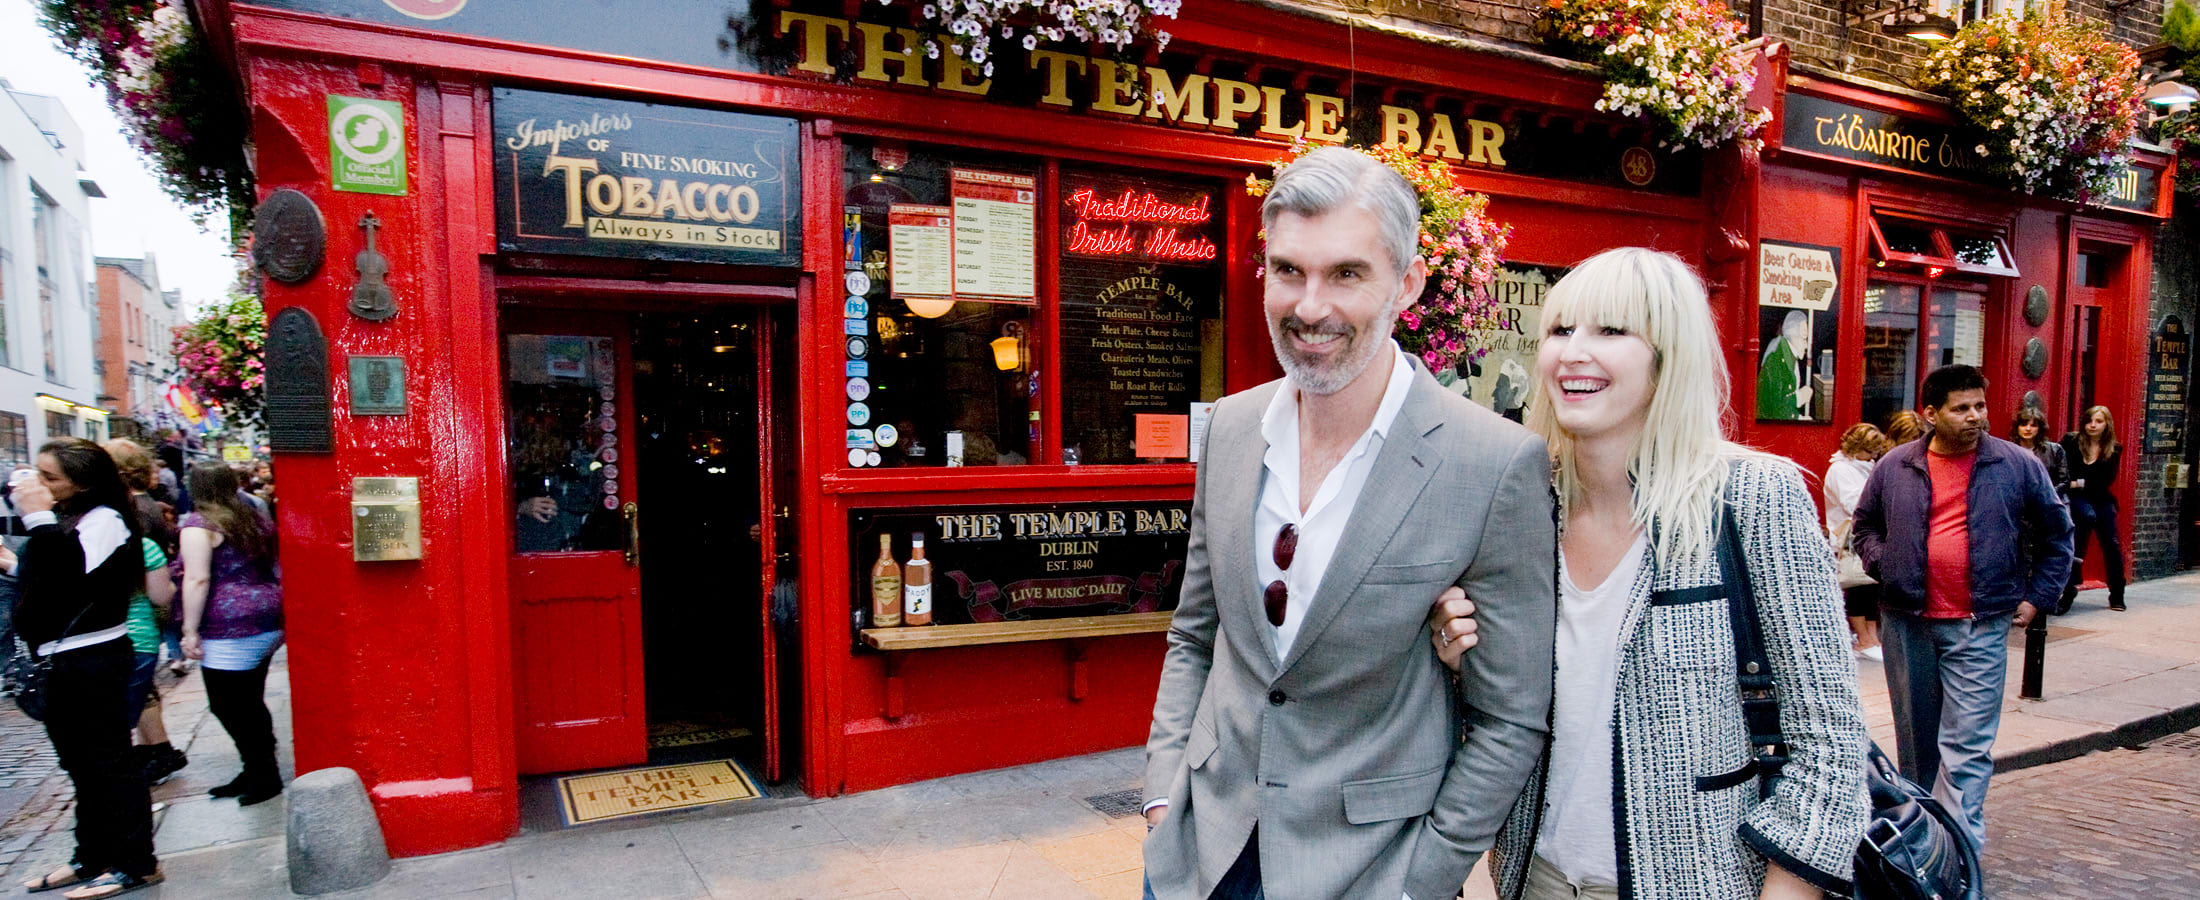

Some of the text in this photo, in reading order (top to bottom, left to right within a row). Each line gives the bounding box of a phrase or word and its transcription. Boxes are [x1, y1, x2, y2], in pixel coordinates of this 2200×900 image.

[780, 10, 1507, 167] THE TEMPLE BAR
[507, 112, 632, 154] Importers
[587, 138, 610, 152] OF
[347, 162, 390, 175] Official
[621, 151, 758, 179] FINE SMOKING
[345, 171, 394, 186] Member
[955, 170, 973, 178] THE
[974, 172, 1012, 182] TEMPLE
[543, 155, 760, 228] TOBACCO
[1073, 190, 1210, 221] Traditional
[592, 219, 777, 246] Always in Stock
[1069, 221, 1216, 259] Irish Music
[1763, 248, 1785, 268] Beer
[1788, 252, 1822, 272] Garden
[1138, 266, 1152, 275] The
[1763, 267, 1802, 291] Smoking
[1096, 276, 1194, 311] TEMPLE BAR
[1770, 287, 1792, 304] Area
[1095, 307, 1193, 322] Traditional Food Fare
[1101, 324, 1120, 336] Meat
[1145, 327, 1170, 338] Cheese
[1172, 328, 1194, 339] Board
[1091, 338, 1113, 349] Fresh
[1145, 341, 1174, 352] Smoked
[2155, 336, 2185, 353] TEMPLE
[1101, 352, 1145, 364] Charcuterie
[2161, 353, 2178, 369] BAR
[1111, 366, 1184, 379] Toasted Sandwiches
[1109, 380, 1186, 393] Hot Roast Beef Rolls
[936, 508, 1190, 543] THE TEMPLE BAR
[1040, 541, 1099, 557] DUBLIN
[1046, 559, 1093, 572] EST. 1840
[1011, 583, 1127, 603] LIVE MUSIC DAILY
[624, 768, 691, 784] THE
[576, 775, 736, 801] TEMPLE
[627, 789, 705, 808] BAR
